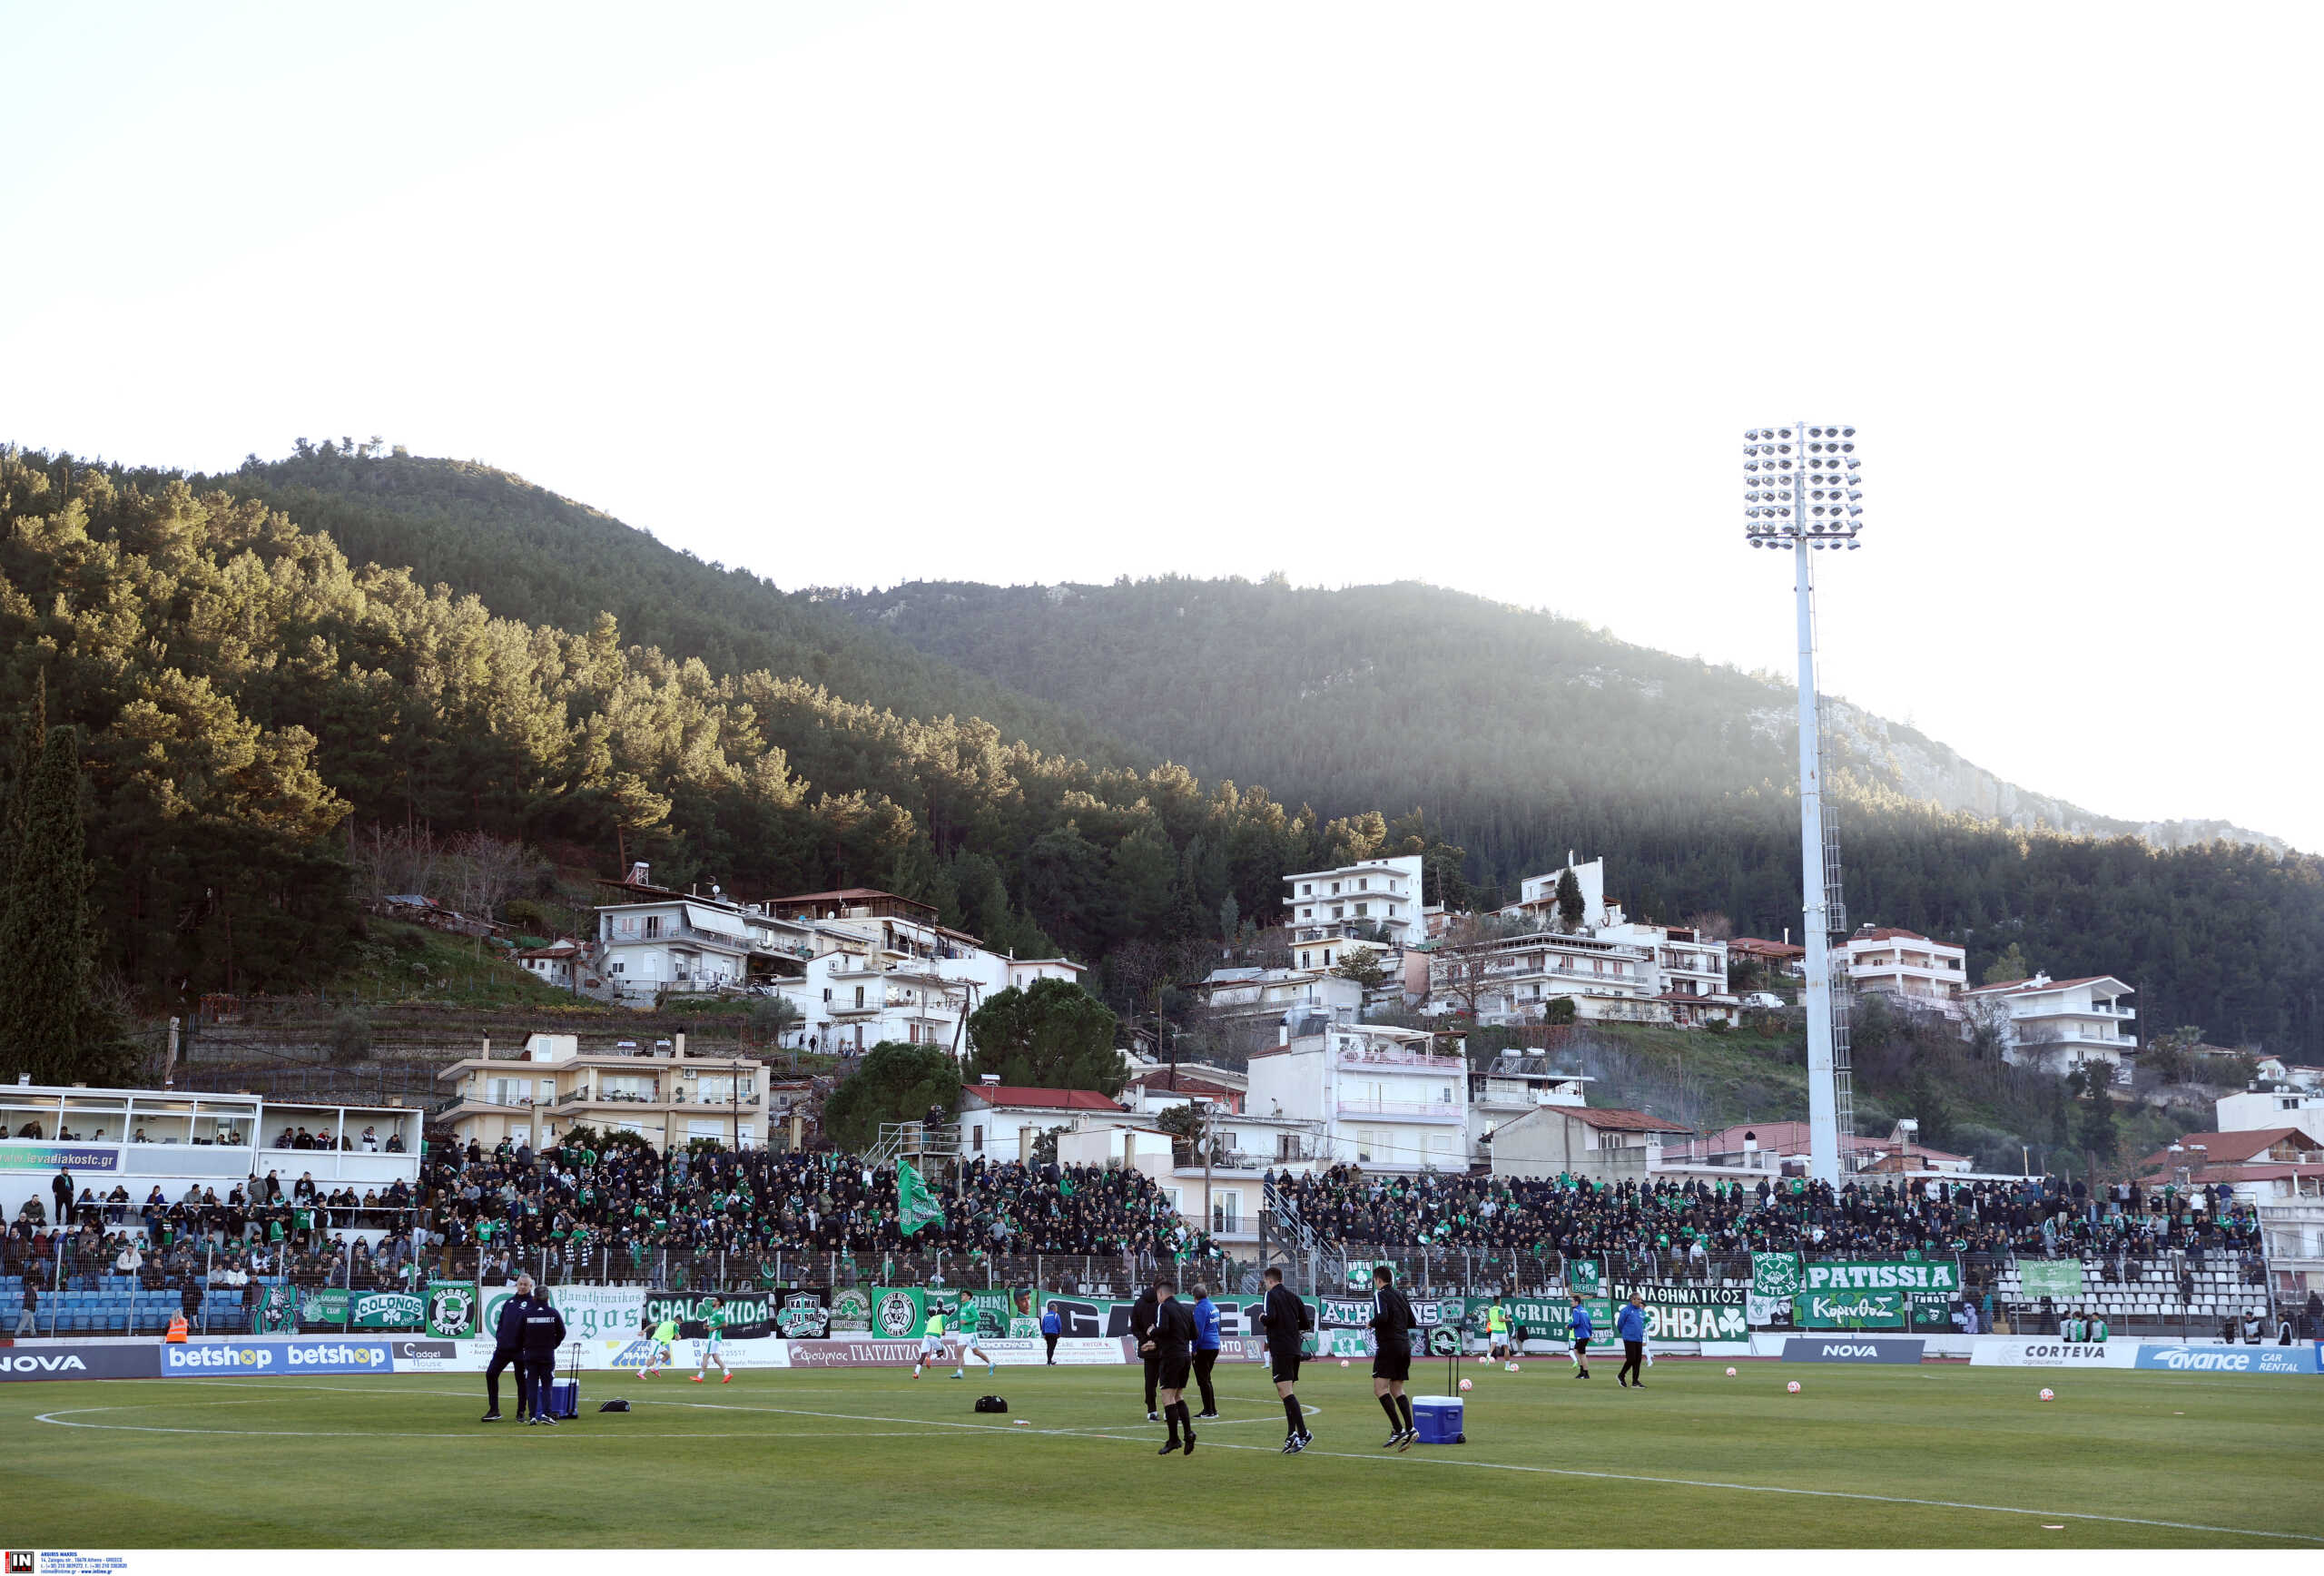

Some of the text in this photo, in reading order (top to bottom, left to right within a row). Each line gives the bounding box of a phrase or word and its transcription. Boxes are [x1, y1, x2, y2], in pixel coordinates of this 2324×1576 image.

[1808, 1266, 1952, 1288] PATISSIA
[1757, 1281, 1786, 1295] GATE
[359, 1296, 421, 1315] COLONOS
[1504, 1304, 1571, 1323] AGRINI
[169, 1345, 272, 1369] betshop
[288, 1344, 386, 1367] betshop
[1822, 1345, 1877, 1357] NOVA
[2025, 1345, 2105, 1358] CORTEVA
[2168, 1351, 2282, 1371] avance CAR
[2259, 1363, 2299, 1372] RENTAL
